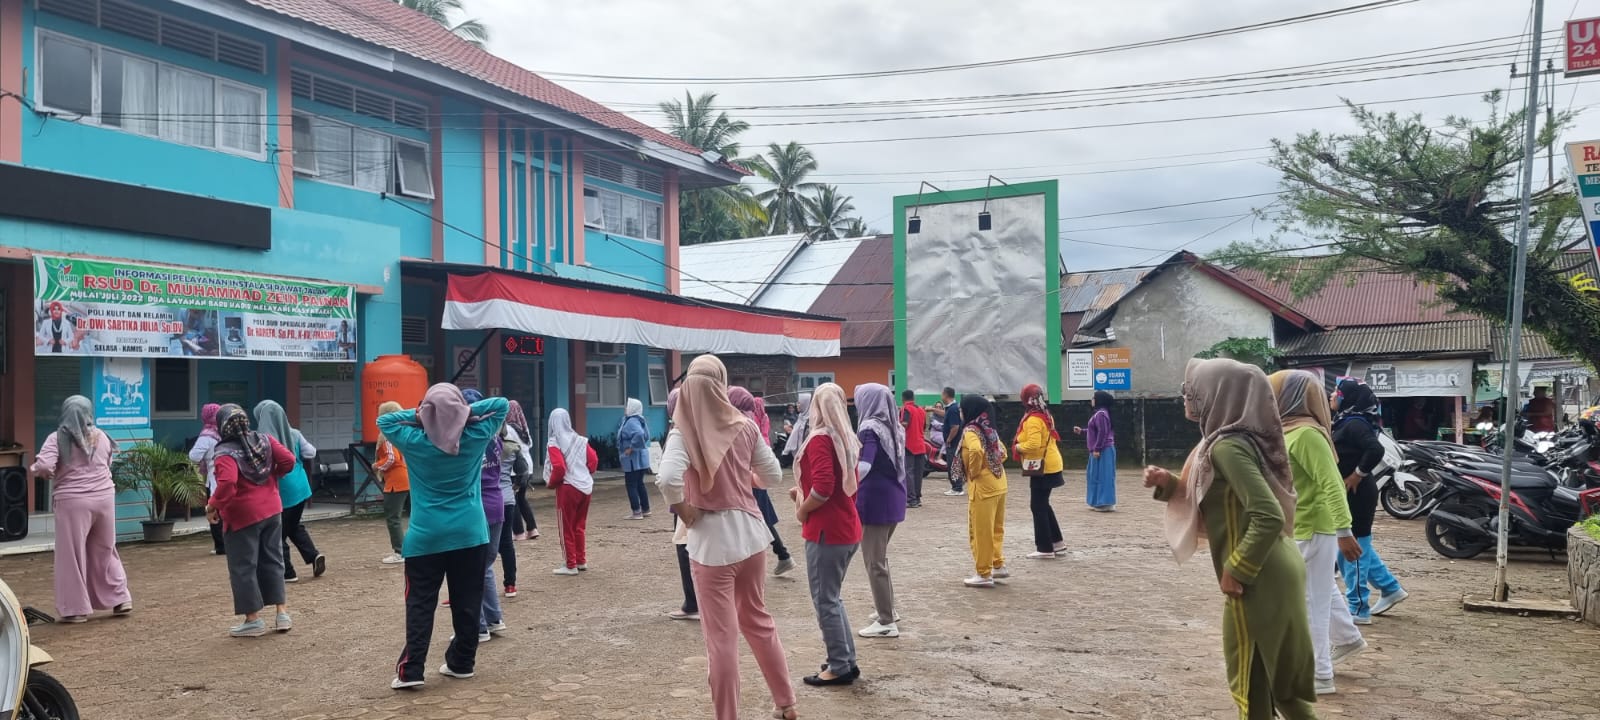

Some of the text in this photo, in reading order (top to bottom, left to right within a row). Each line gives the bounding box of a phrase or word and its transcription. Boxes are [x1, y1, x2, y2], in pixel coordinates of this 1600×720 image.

[1571, 22, 1600, 43] U
[1571, 43, 1598, 58] 24
[115, 269, 328, 295] INFORMASI PELAYANAN INSTALASI RAWAT JALAN
[70, 291, 99, 299] MULAI
[148, 296, 164, 304] DUA
[167, 297, 206, 306] LAYANAN
[84, 275, 349, 307] RSUD Dr. MUHAMMAD ZEIN PAINAN
[143, 311, 173, 320] KELAMIN
[77, 318, 87, 329] Dr.
[94, 344, 118, 352] SELASA
[1370, 373, 1388, 386] 12
